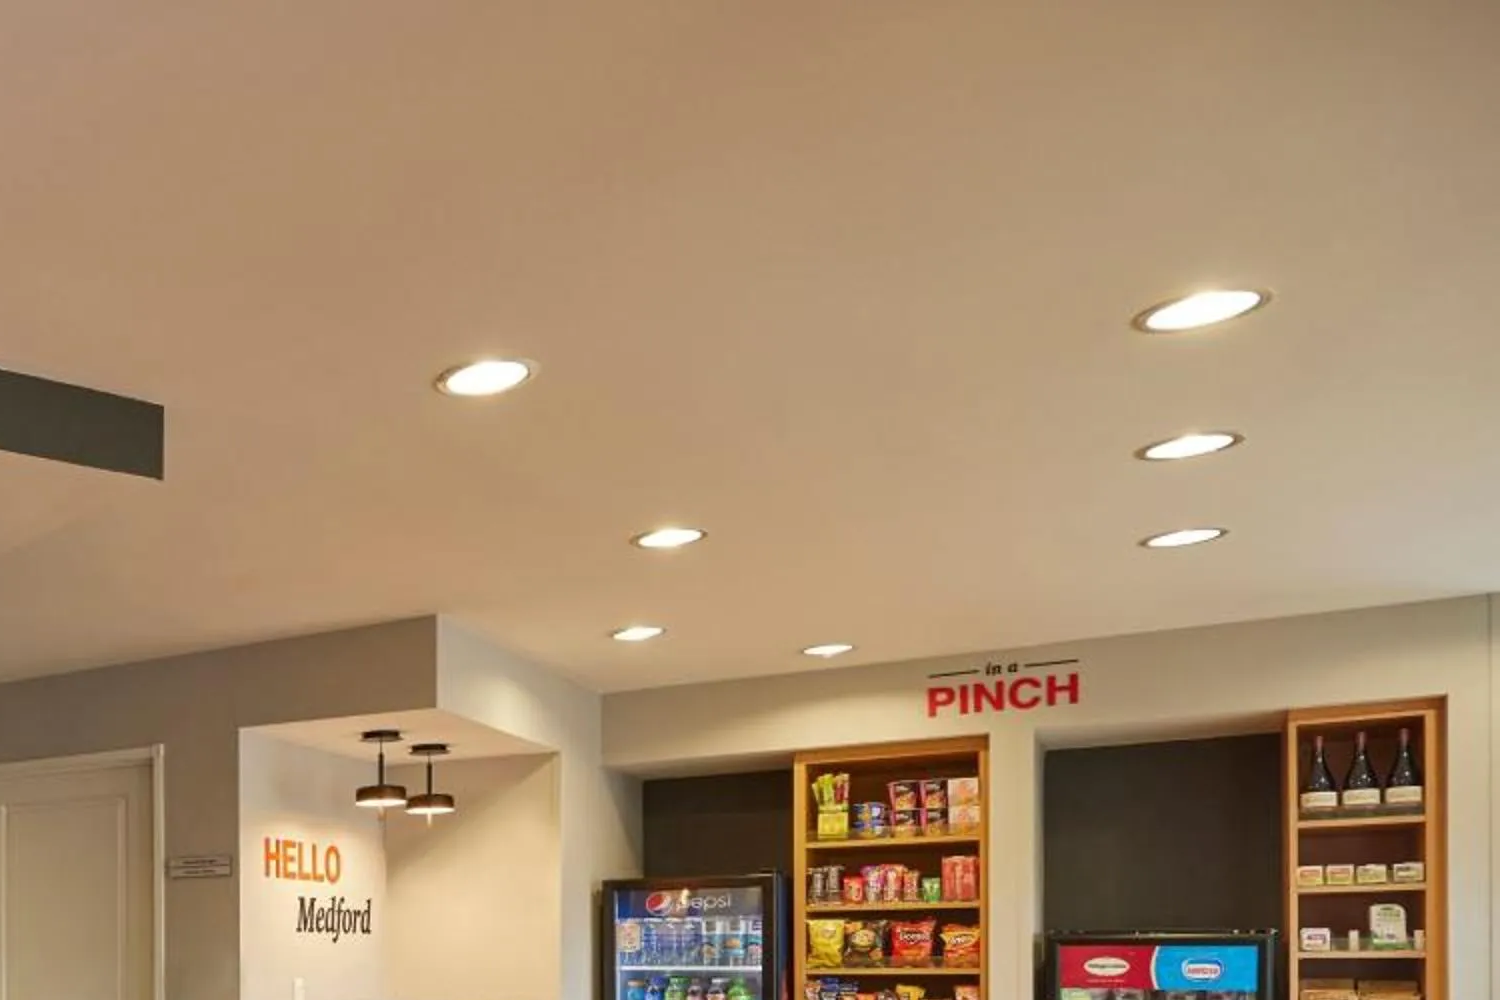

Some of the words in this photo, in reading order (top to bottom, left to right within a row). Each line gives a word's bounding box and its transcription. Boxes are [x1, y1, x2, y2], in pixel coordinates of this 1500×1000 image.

[985, 661, 1002, 676] in
[1007, 661, 1019, 674] a
[927, 672, 1079, 718] PINCH
[264, 837, 342, 884] HELLO
[296, 896, 373, 943] Medford
